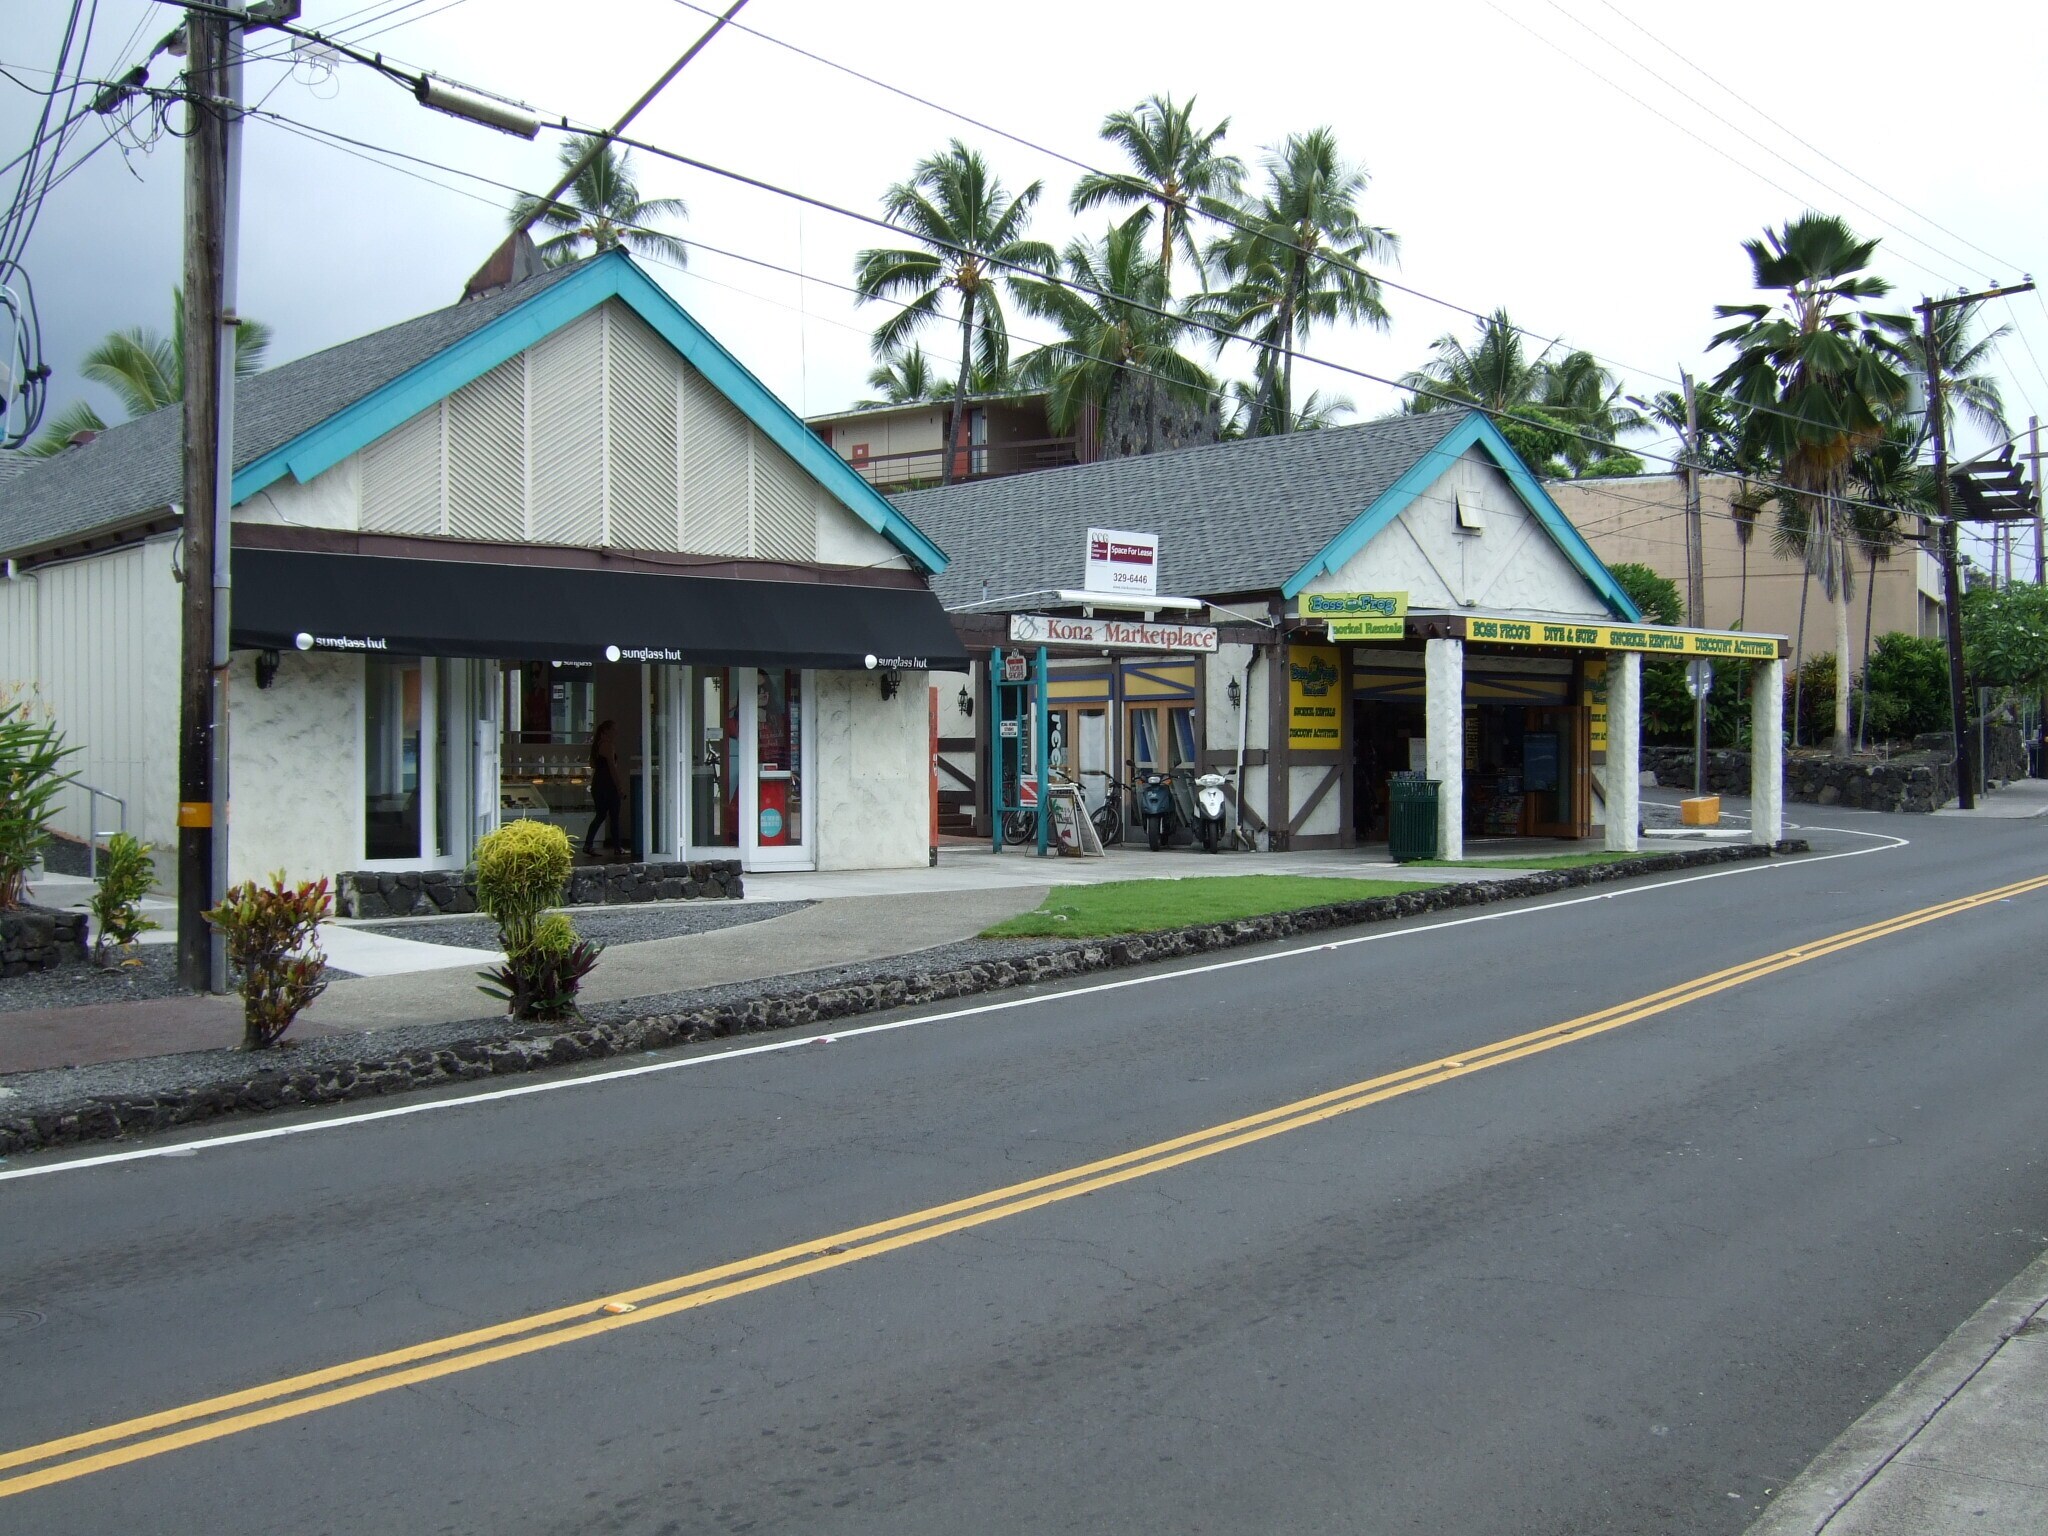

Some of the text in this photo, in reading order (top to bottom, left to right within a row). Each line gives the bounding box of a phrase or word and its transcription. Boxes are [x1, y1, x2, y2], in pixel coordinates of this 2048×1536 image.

[1111, 545, 1153, 558] Space For Lease
[1113, 572, 1148, 585] 329-6446
[1311, 595, 1396, 616] Boss Frog
[1047, 619, 1213, 649] Kona Marketplace
[1333, 622, 1403, 635] norkel Rentals
[316, 636, 387, 649] sunglass hut
[1473, 621, 1498, 638] BOSS
[1544, 625, 1565, 642] DIVE
[1695, 637, 1733, 653] DISCOUNT
[622, 647, 682, 662] sunglass hut
[878, 656, 928, 670] sunglass hut
